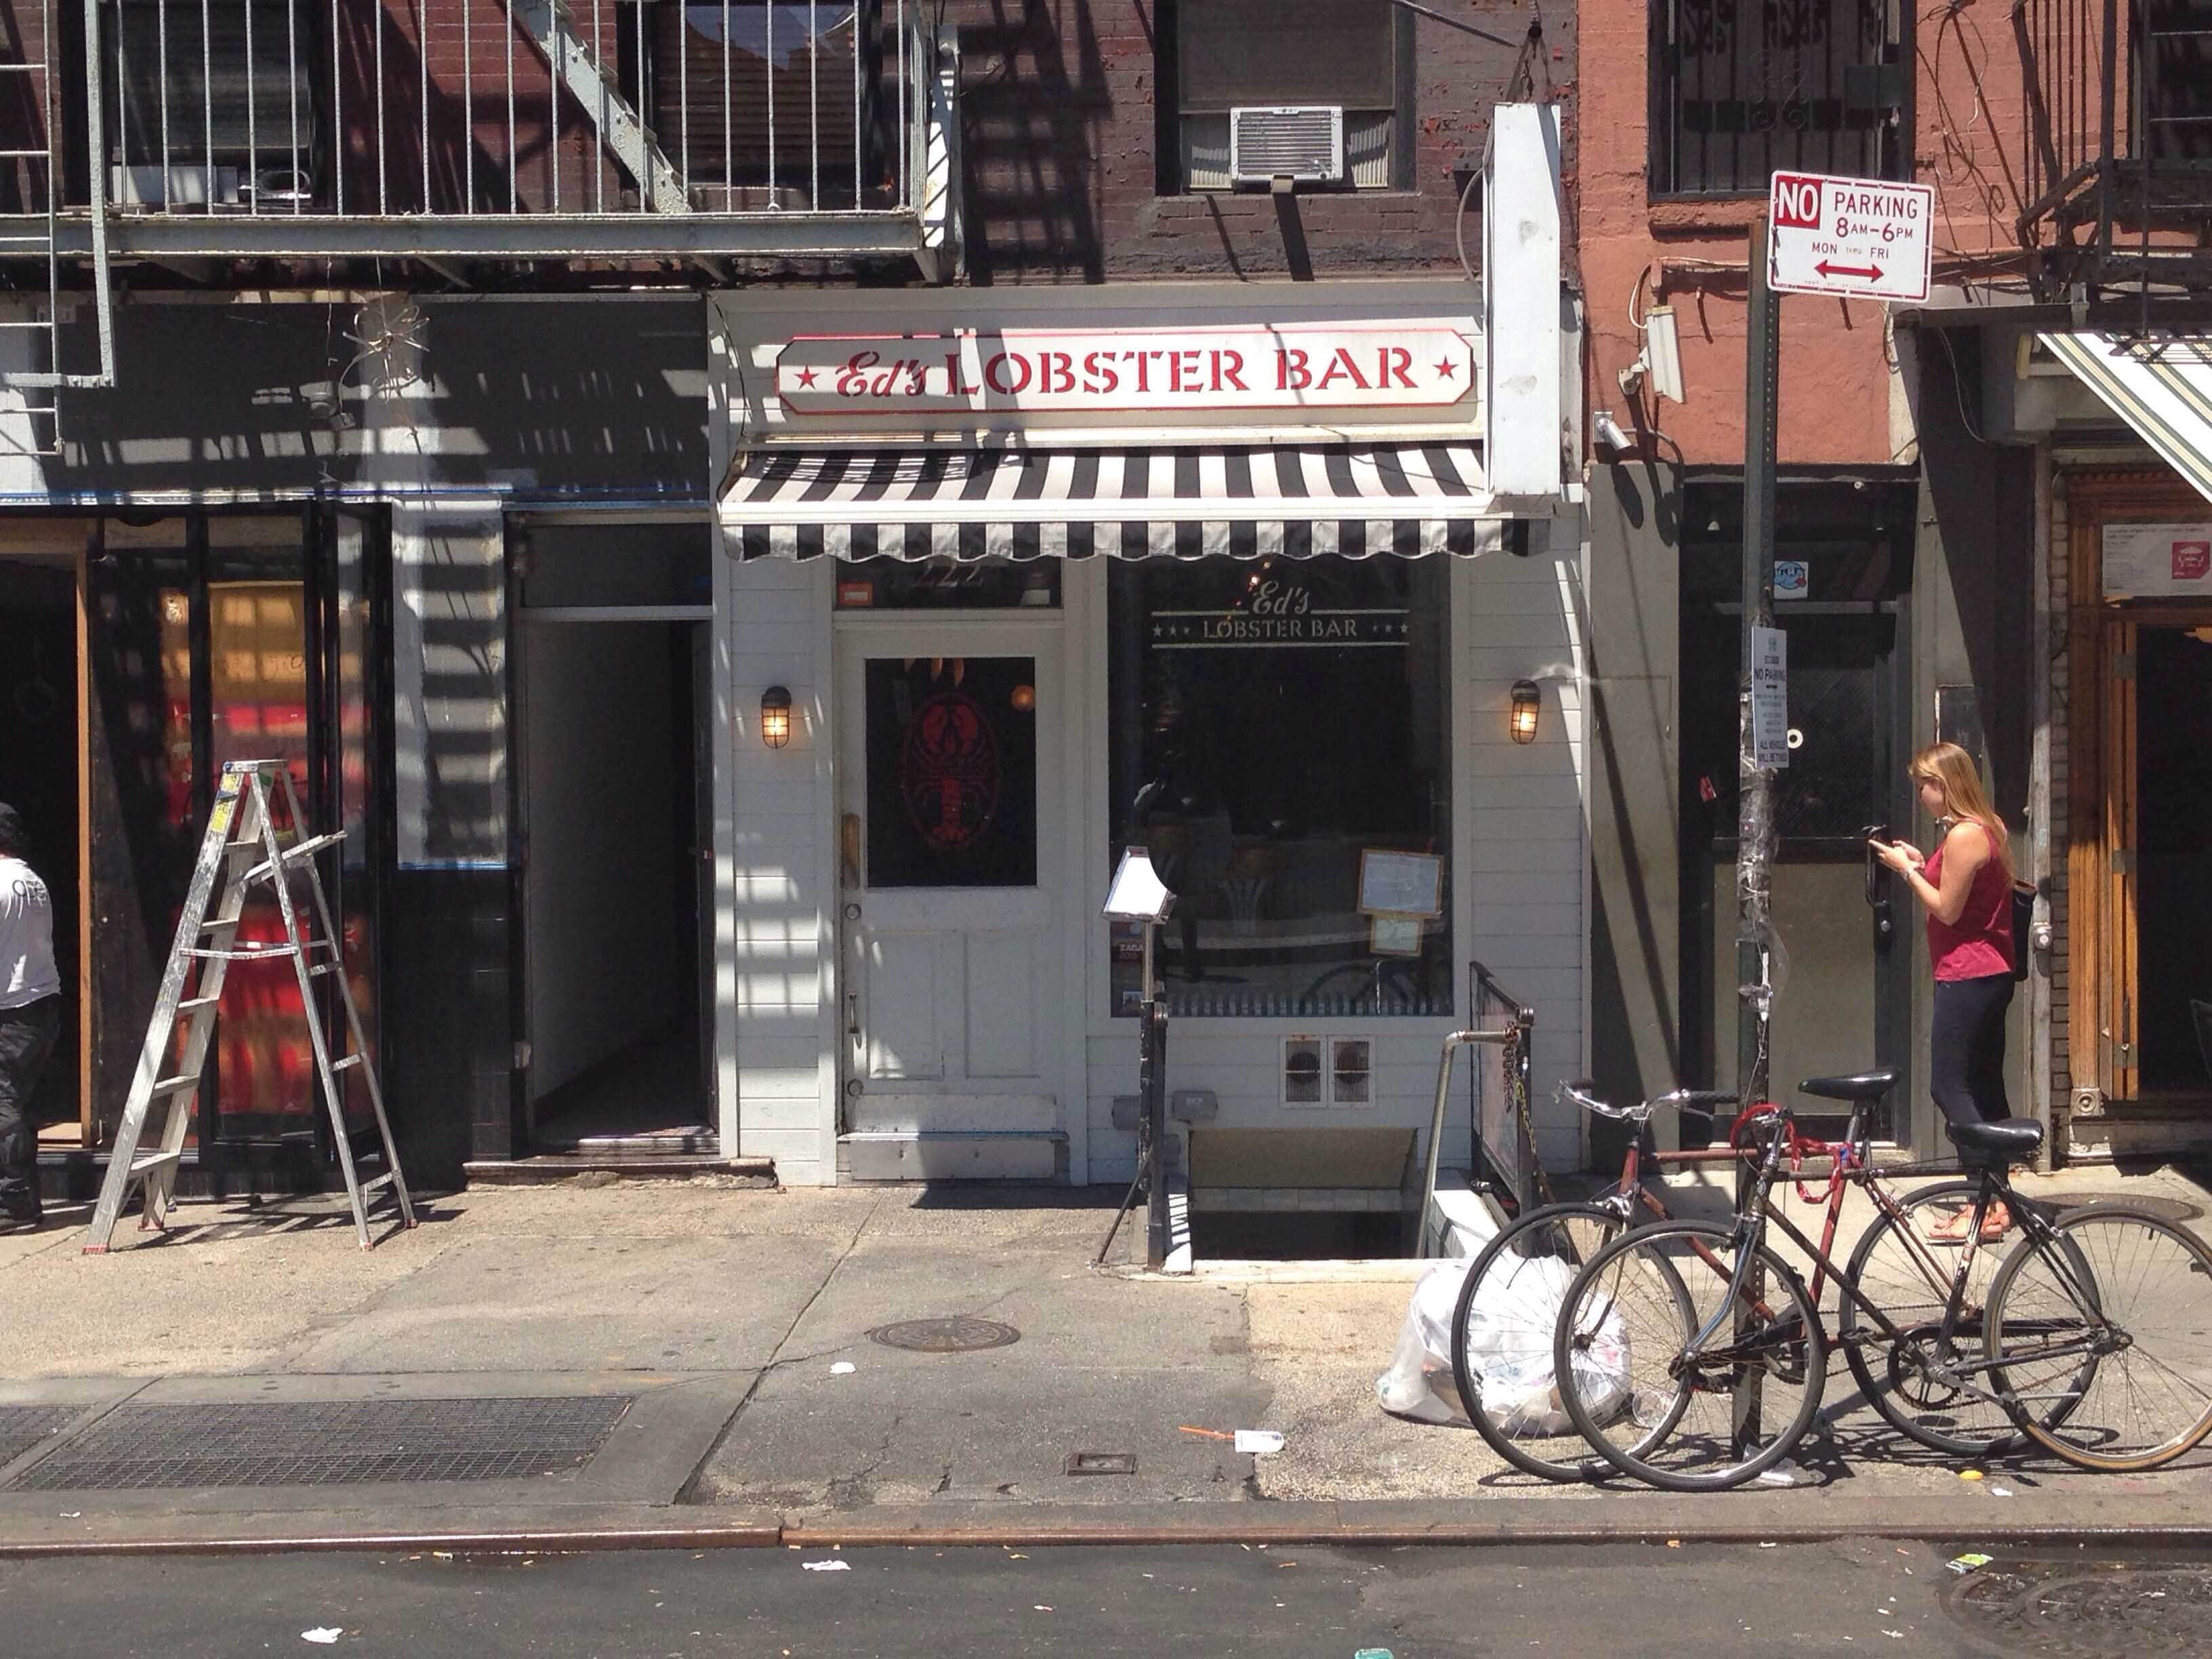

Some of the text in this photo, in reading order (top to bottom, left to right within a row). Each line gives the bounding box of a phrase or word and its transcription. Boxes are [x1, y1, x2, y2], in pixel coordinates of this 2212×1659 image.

[1778, 181, 1918, 222] NO PARKING
[1811, 241, 1837, 255] MON
[1870, 247, 1889, 260] FRI
[834, 347, 1419, 398] Ed's LOBSTER BAR
[1252, 580, 1311, 616] Ed's
[1203, 618, 1357, 639] LOBSTER BAR
[1119, 943, 1145, 951] ZAGA
